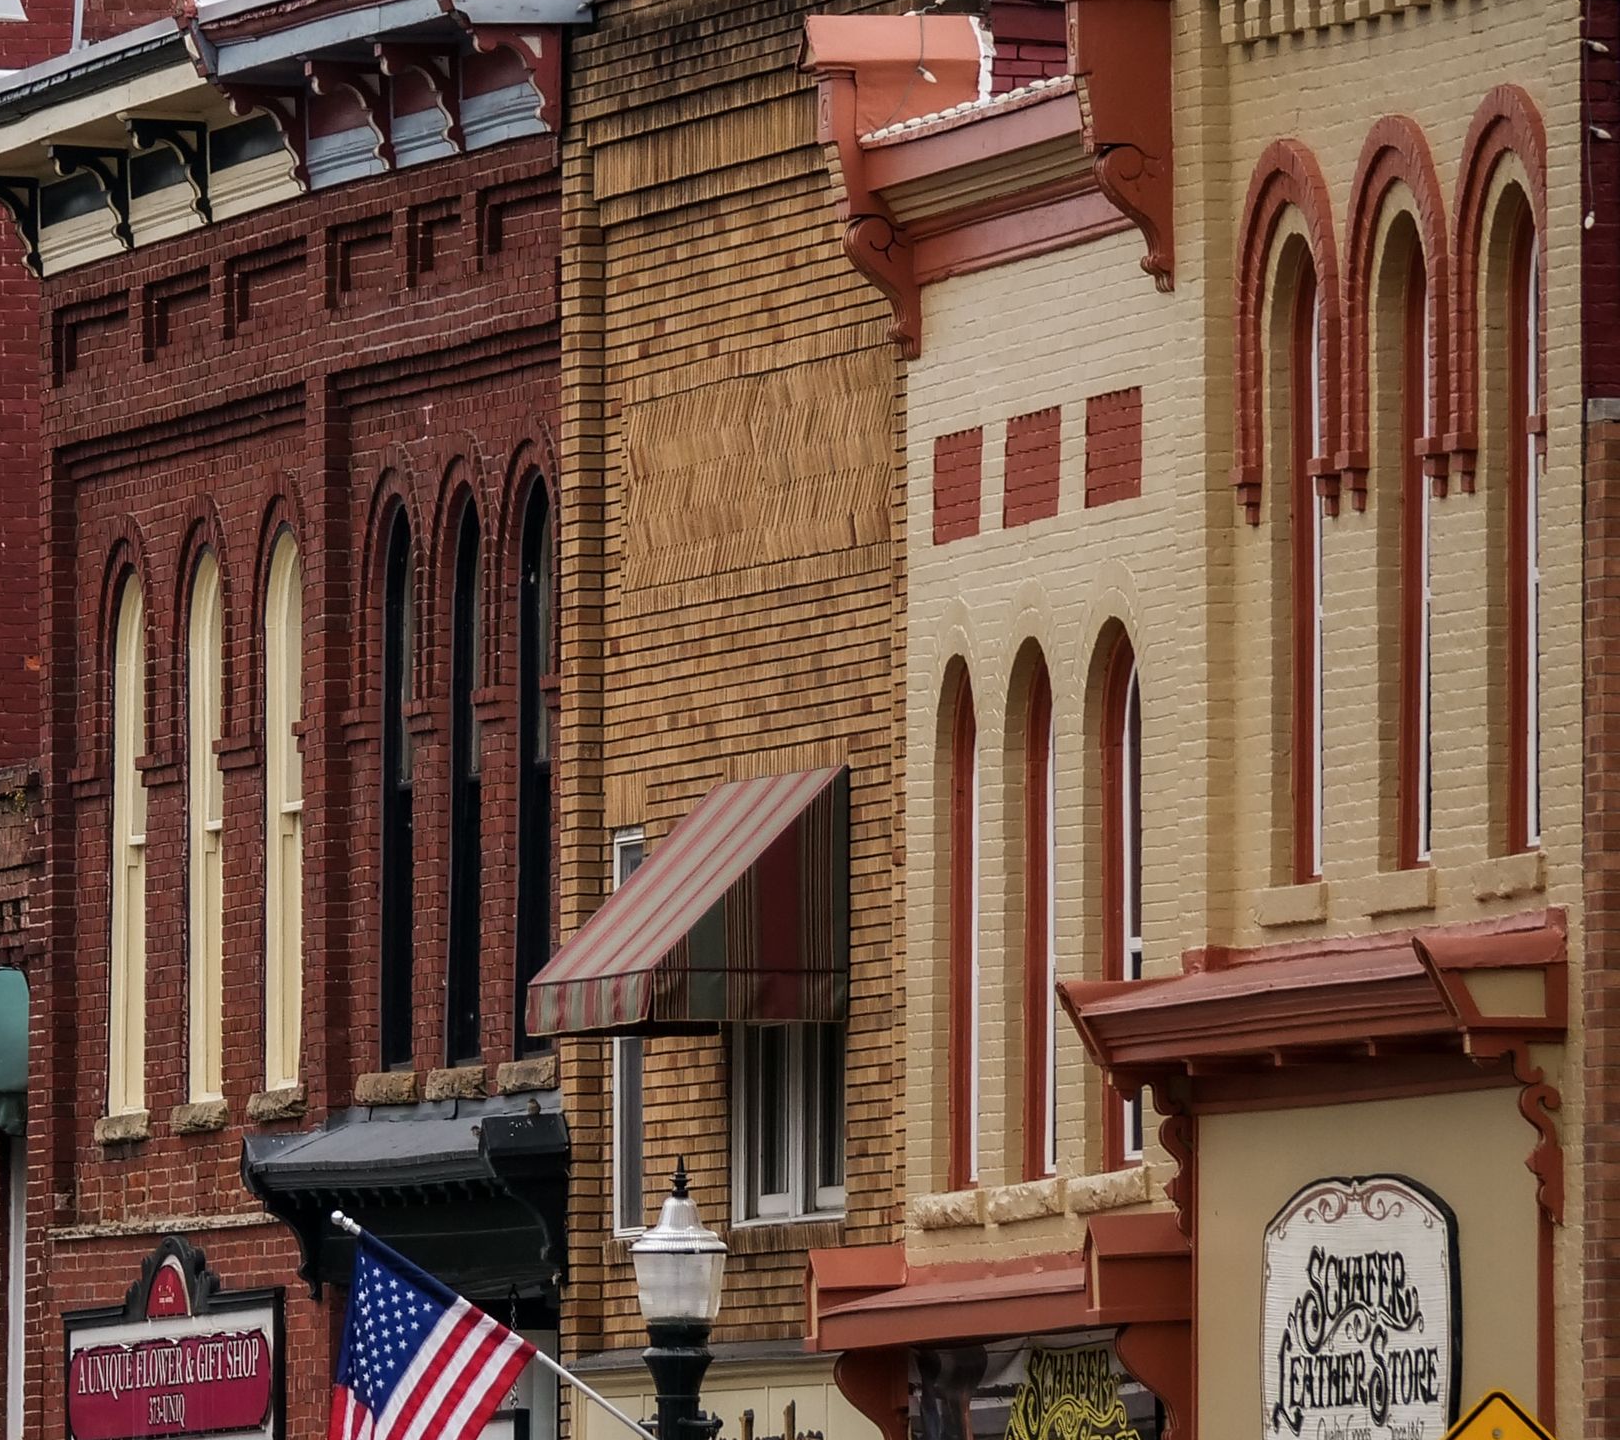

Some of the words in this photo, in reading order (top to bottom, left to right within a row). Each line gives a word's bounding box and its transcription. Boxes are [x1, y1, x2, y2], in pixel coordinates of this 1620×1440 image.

[1302, 1245, 1419, 1354] SCHAFER
[77, 1356, 88, 1394] A
[88, 1351, 133, 1400] UNIQUE
[136, 1344, 184, 1389] FLOWER
[185, 1347, 195, 1384] &
[197, 1341, 225, 1382] GIFT
[226, 1338, 260, 1380] SHOP
[148, 1393, 185, 1429] 373-UNIQ
[1272, 1328, 1368, 1437] LEATHER
[1369, 1323, 1439, 1427] STORE
